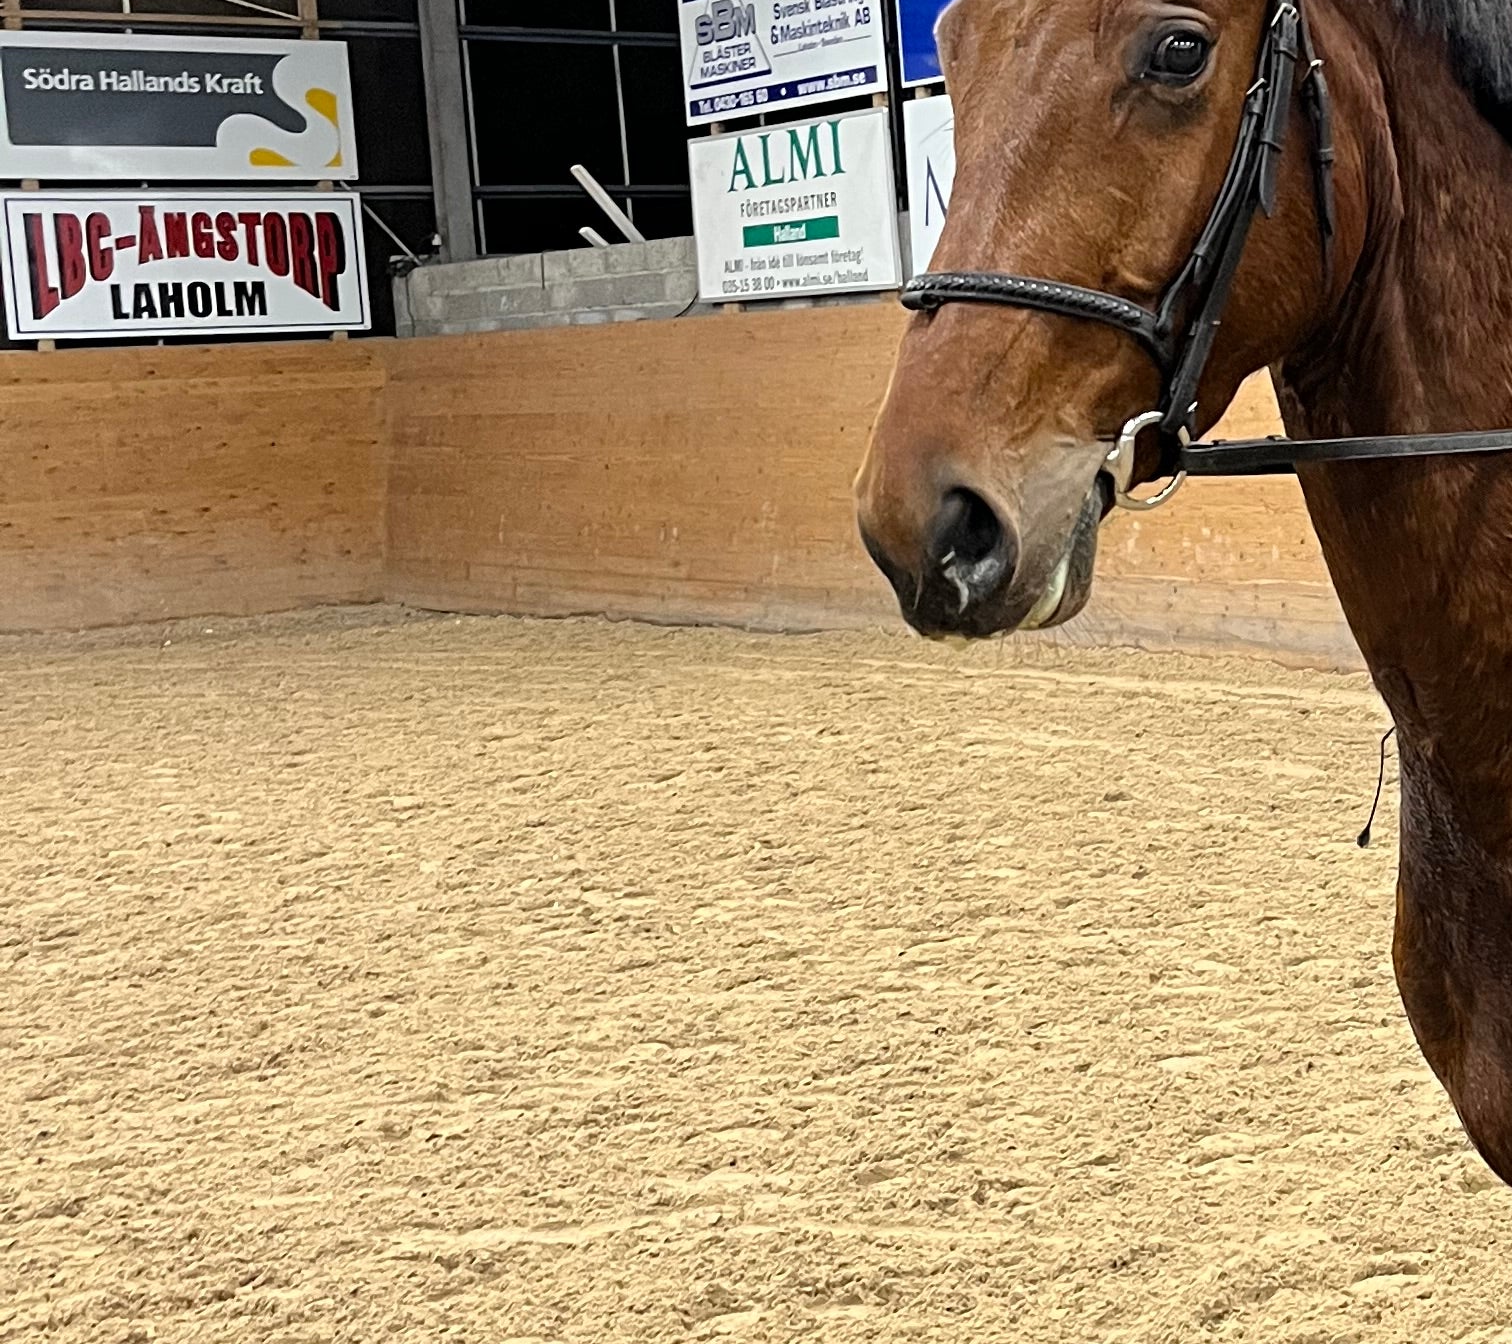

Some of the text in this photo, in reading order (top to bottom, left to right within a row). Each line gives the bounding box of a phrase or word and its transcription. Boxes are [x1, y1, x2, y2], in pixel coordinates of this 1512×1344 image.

[695, 0, 756, 46] SBM
[771, 25, 778, 44] &
[855, 7, 870, 27] AB
[701, 57, 756, 78] MASKINER
[22, 68, 263, 95] Södra Hallands Kraft
[727, 119, 846, 193] ALMI
[740, 192, 837, 217] FÖRETAGSPARTNER
[773, 223, 806, 243] Halland
[764, 276, 774, 290] 00
[111, 281, 268, 319] LAHOLM
